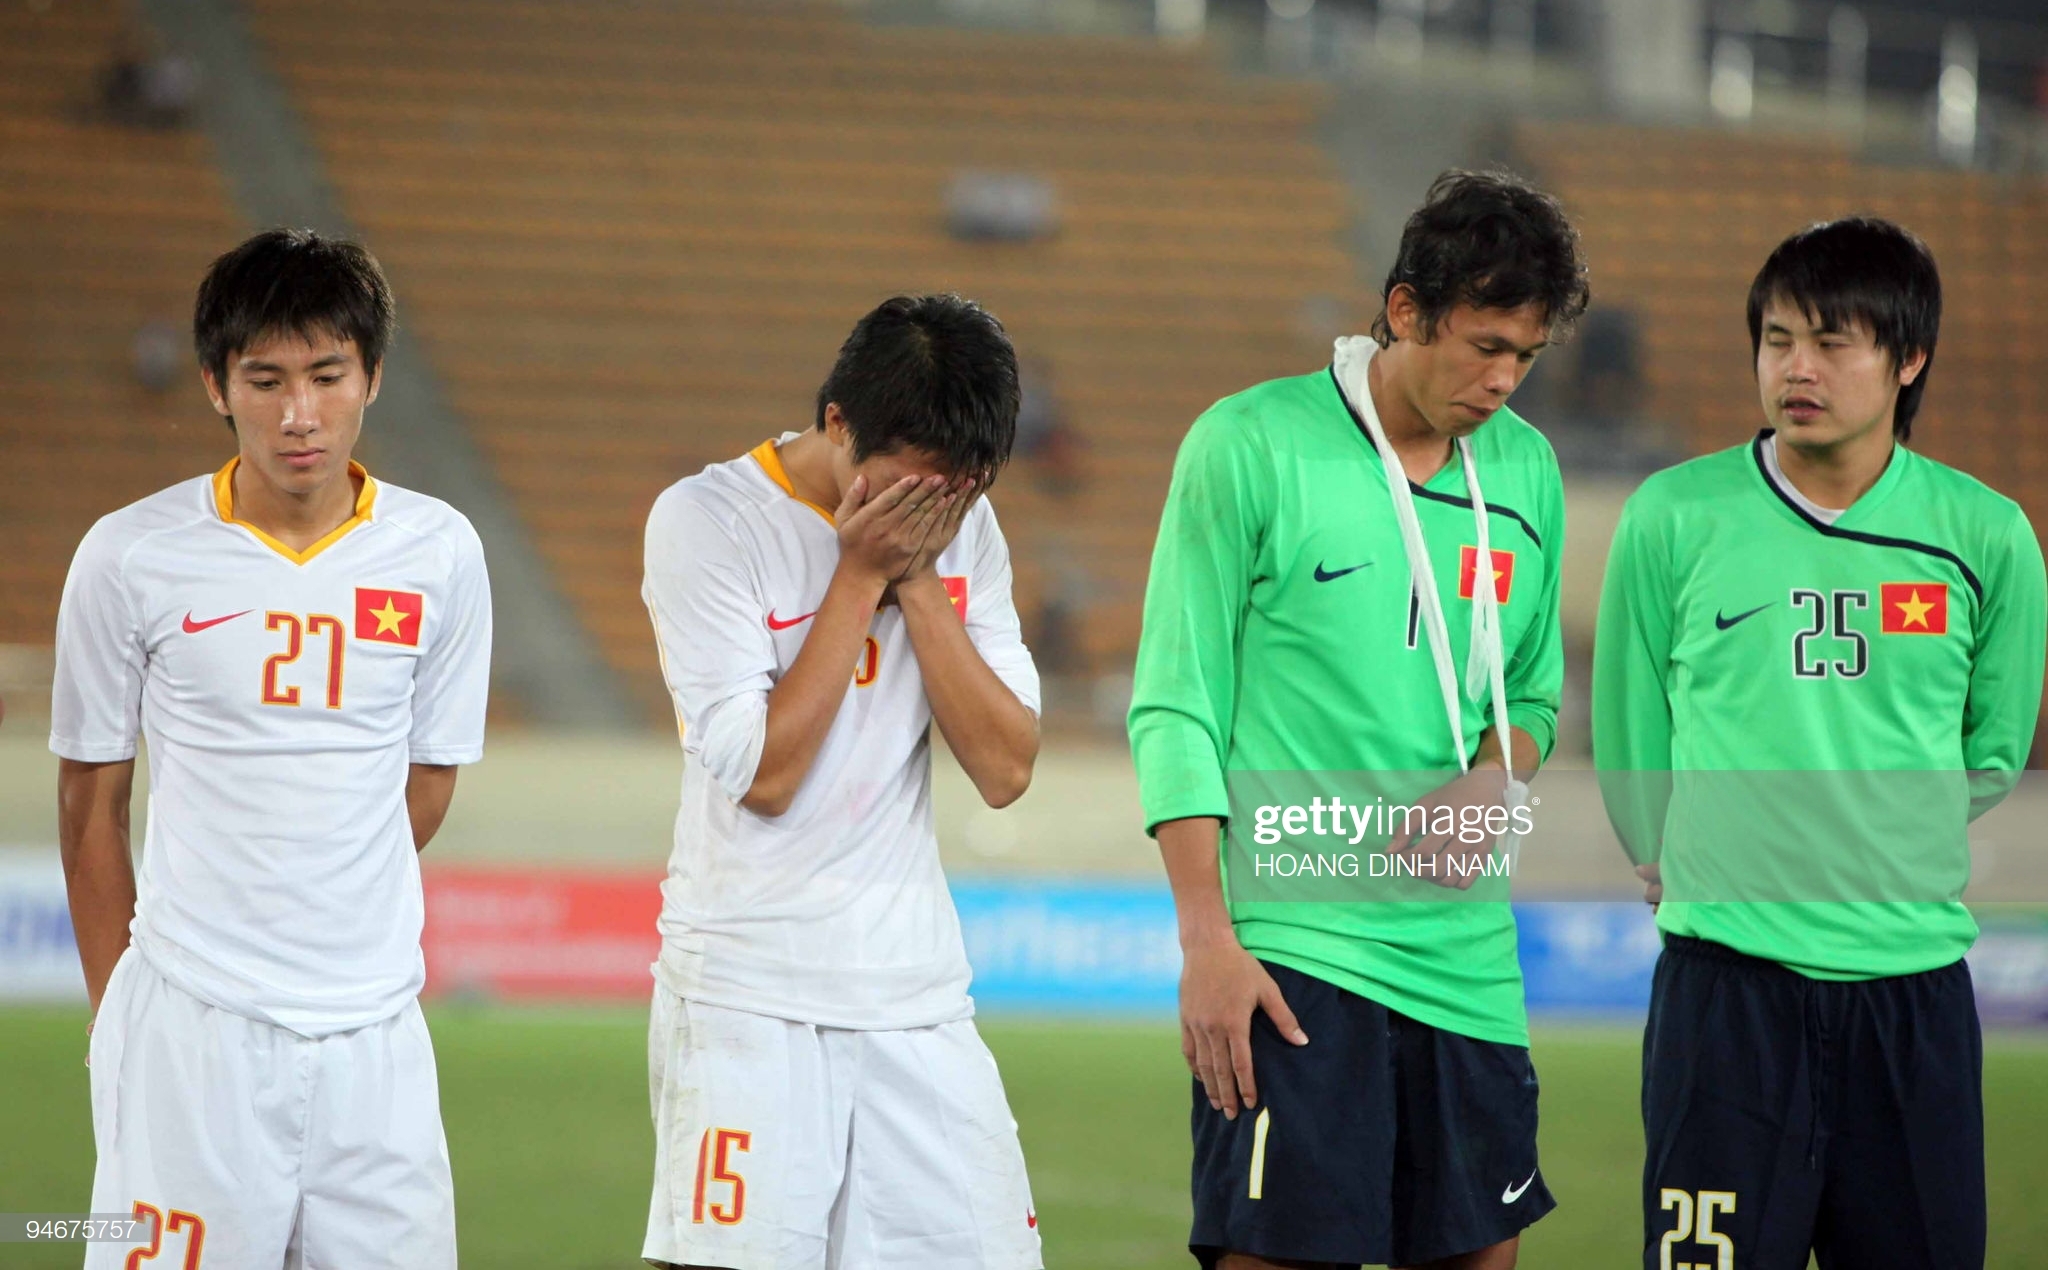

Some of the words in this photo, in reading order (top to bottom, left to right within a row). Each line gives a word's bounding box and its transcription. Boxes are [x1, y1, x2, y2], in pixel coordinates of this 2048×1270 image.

[261, 610, 345, 710] 27
[1790, 588, 1869, 680] 25
[692, 1126, 752, 1225] 15
[1248, 1106, 1270, 1199] 1
[124, 1200, 206, 1270] 27
[1660, 1187, 1736, 1270] 25
